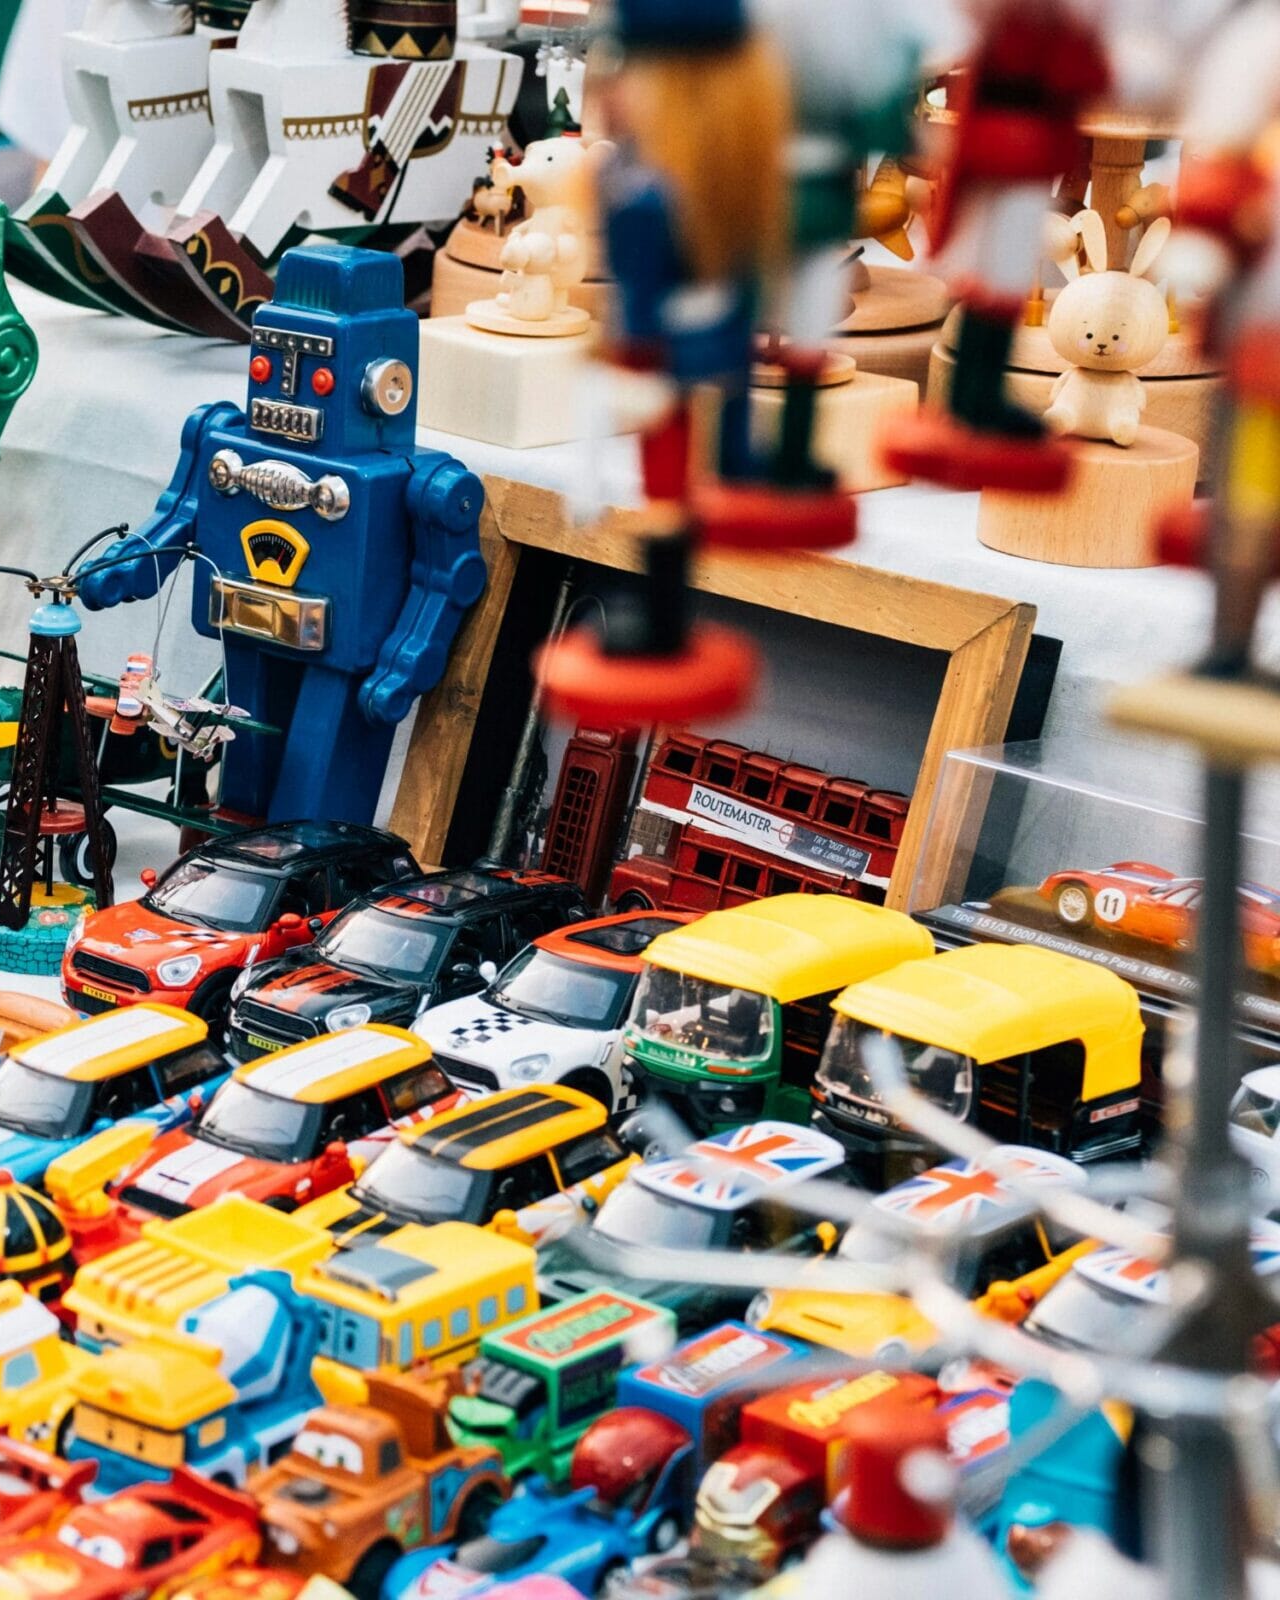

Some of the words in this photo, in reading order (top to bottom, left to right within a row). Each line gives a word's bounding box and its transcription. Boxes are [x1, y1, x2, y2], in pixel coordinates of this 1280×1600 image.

[693, 790, 771, 832] ROUTEMASTER
[813, 835, 828, 846] TRY
[1102, 894, 1119, 916] 11
[951, 909, 975, 924] Tipo
[1008, 926, 1036, 940] 1000
[1035, 934, 1093, 958] kilomètres
[1092, 952, 1109, 963] de
[1109, 956, 1139, 972] Paris
